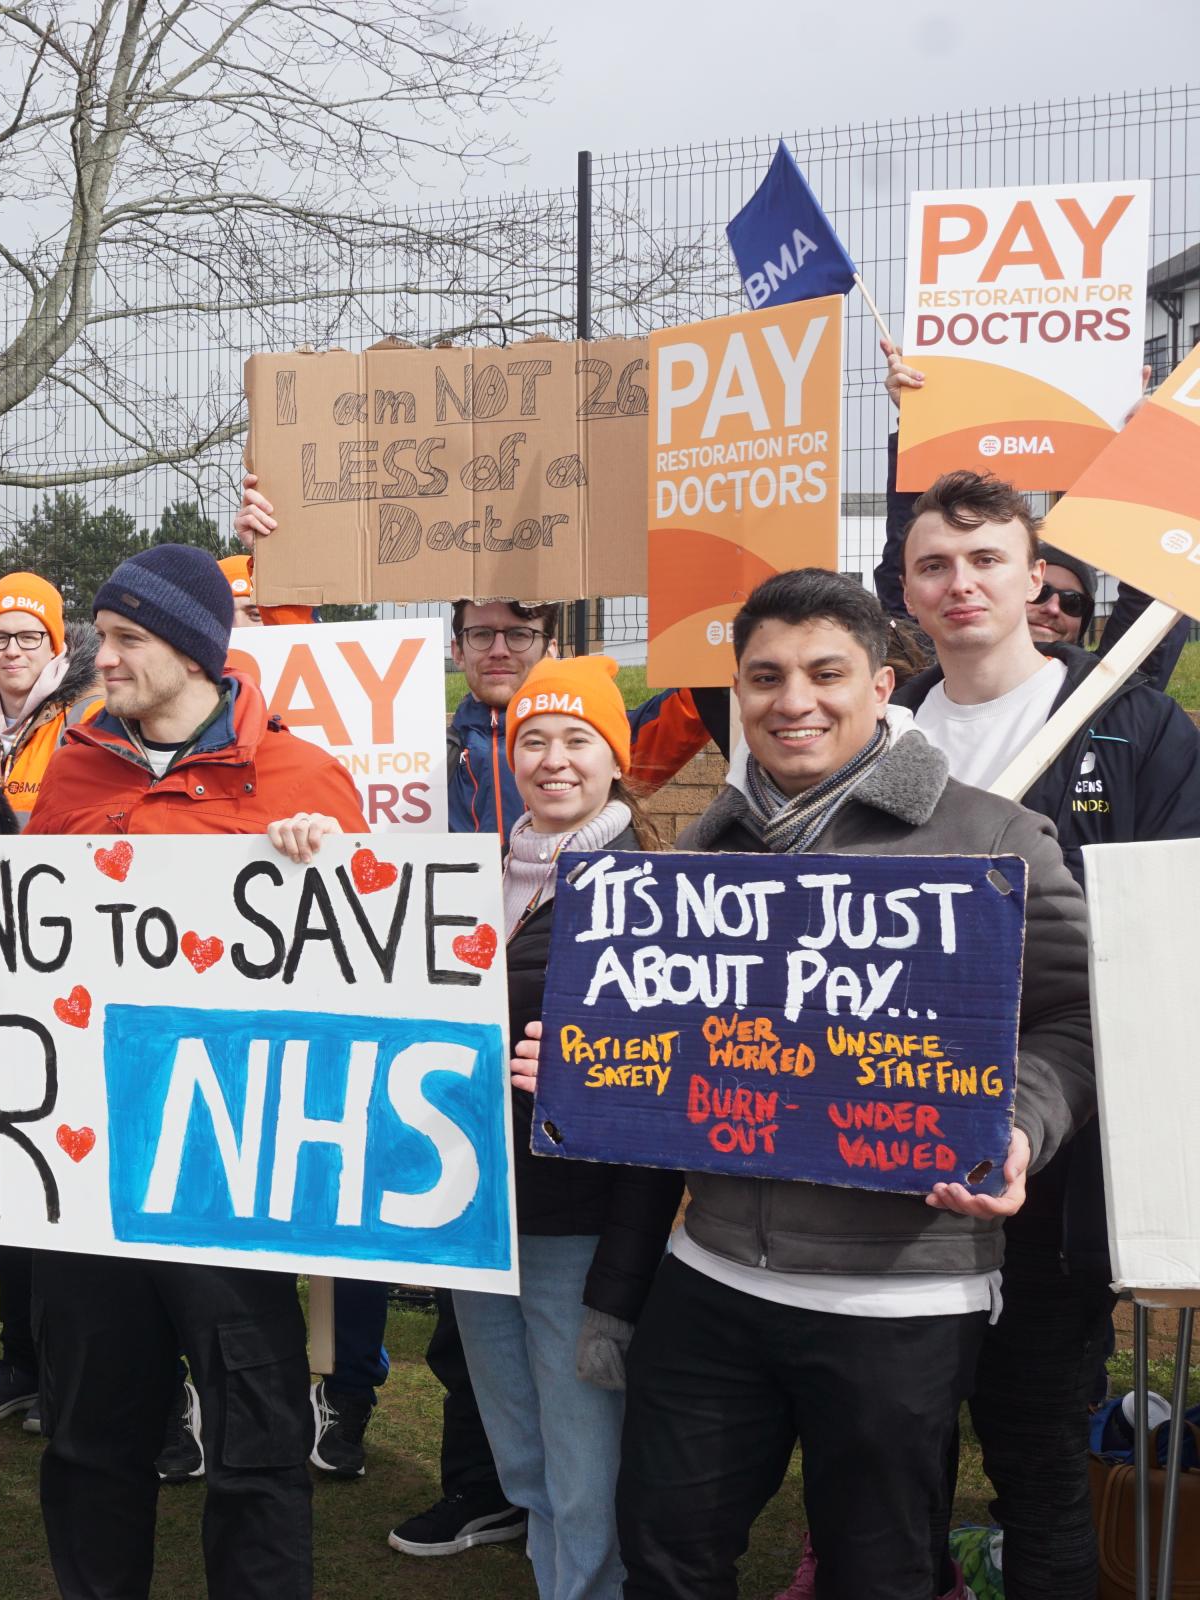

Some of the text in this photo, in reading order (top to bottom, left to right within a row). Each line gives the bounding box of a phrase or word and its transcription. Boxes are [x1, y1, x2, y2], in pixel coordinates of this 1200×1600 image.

[919, 194, 1136, 285] PAY
[745, 228, 818, 310] BMA
[918, 284, 1133, 308] RESTORATION FOR
[916, 308, 1131, 346] DOCTORS
[276, 358, 649, 426] I am NOT 26
[657, 316, 830, 445] PAY
[656, 431, 829, 472] RESTORATION FOR
[1003, 436, 1055, 455] BMA
[302, 432, 588, 500] LESS of a
[656, 461, 828, 519] DOCTORS
[378, 504, 569, 564] Doctor
[16, 596, 46, 615] BMA
[535, 693, 584, 715] BMA
[378, 751, 431, 775] FOR
[95, 903, 178, 969] TO
[231, 860, 482, 986] SAVE
[573, 855, 973, 954] IT'S NOT JUST
[583, 945, 764, 1012] ABOUT
[560, 1024, 680, 1064] PATIENT
[701, 1013, 779, 1045] OVER
[826, 1025, 944, 1058] UNSAFE
[708, 1043, 816, 1077] WORKED
[857, 1057, 1004, 1097] STAFFING
[584, 1065, 672, 1096] SAFETY
[142, 1037, 482, 1229] NHS
[708, 1122, 779, 1155] OUT
[828, 1101, 946, 1138] UNDER
[838, 1134, 957, 1171] VALUED
